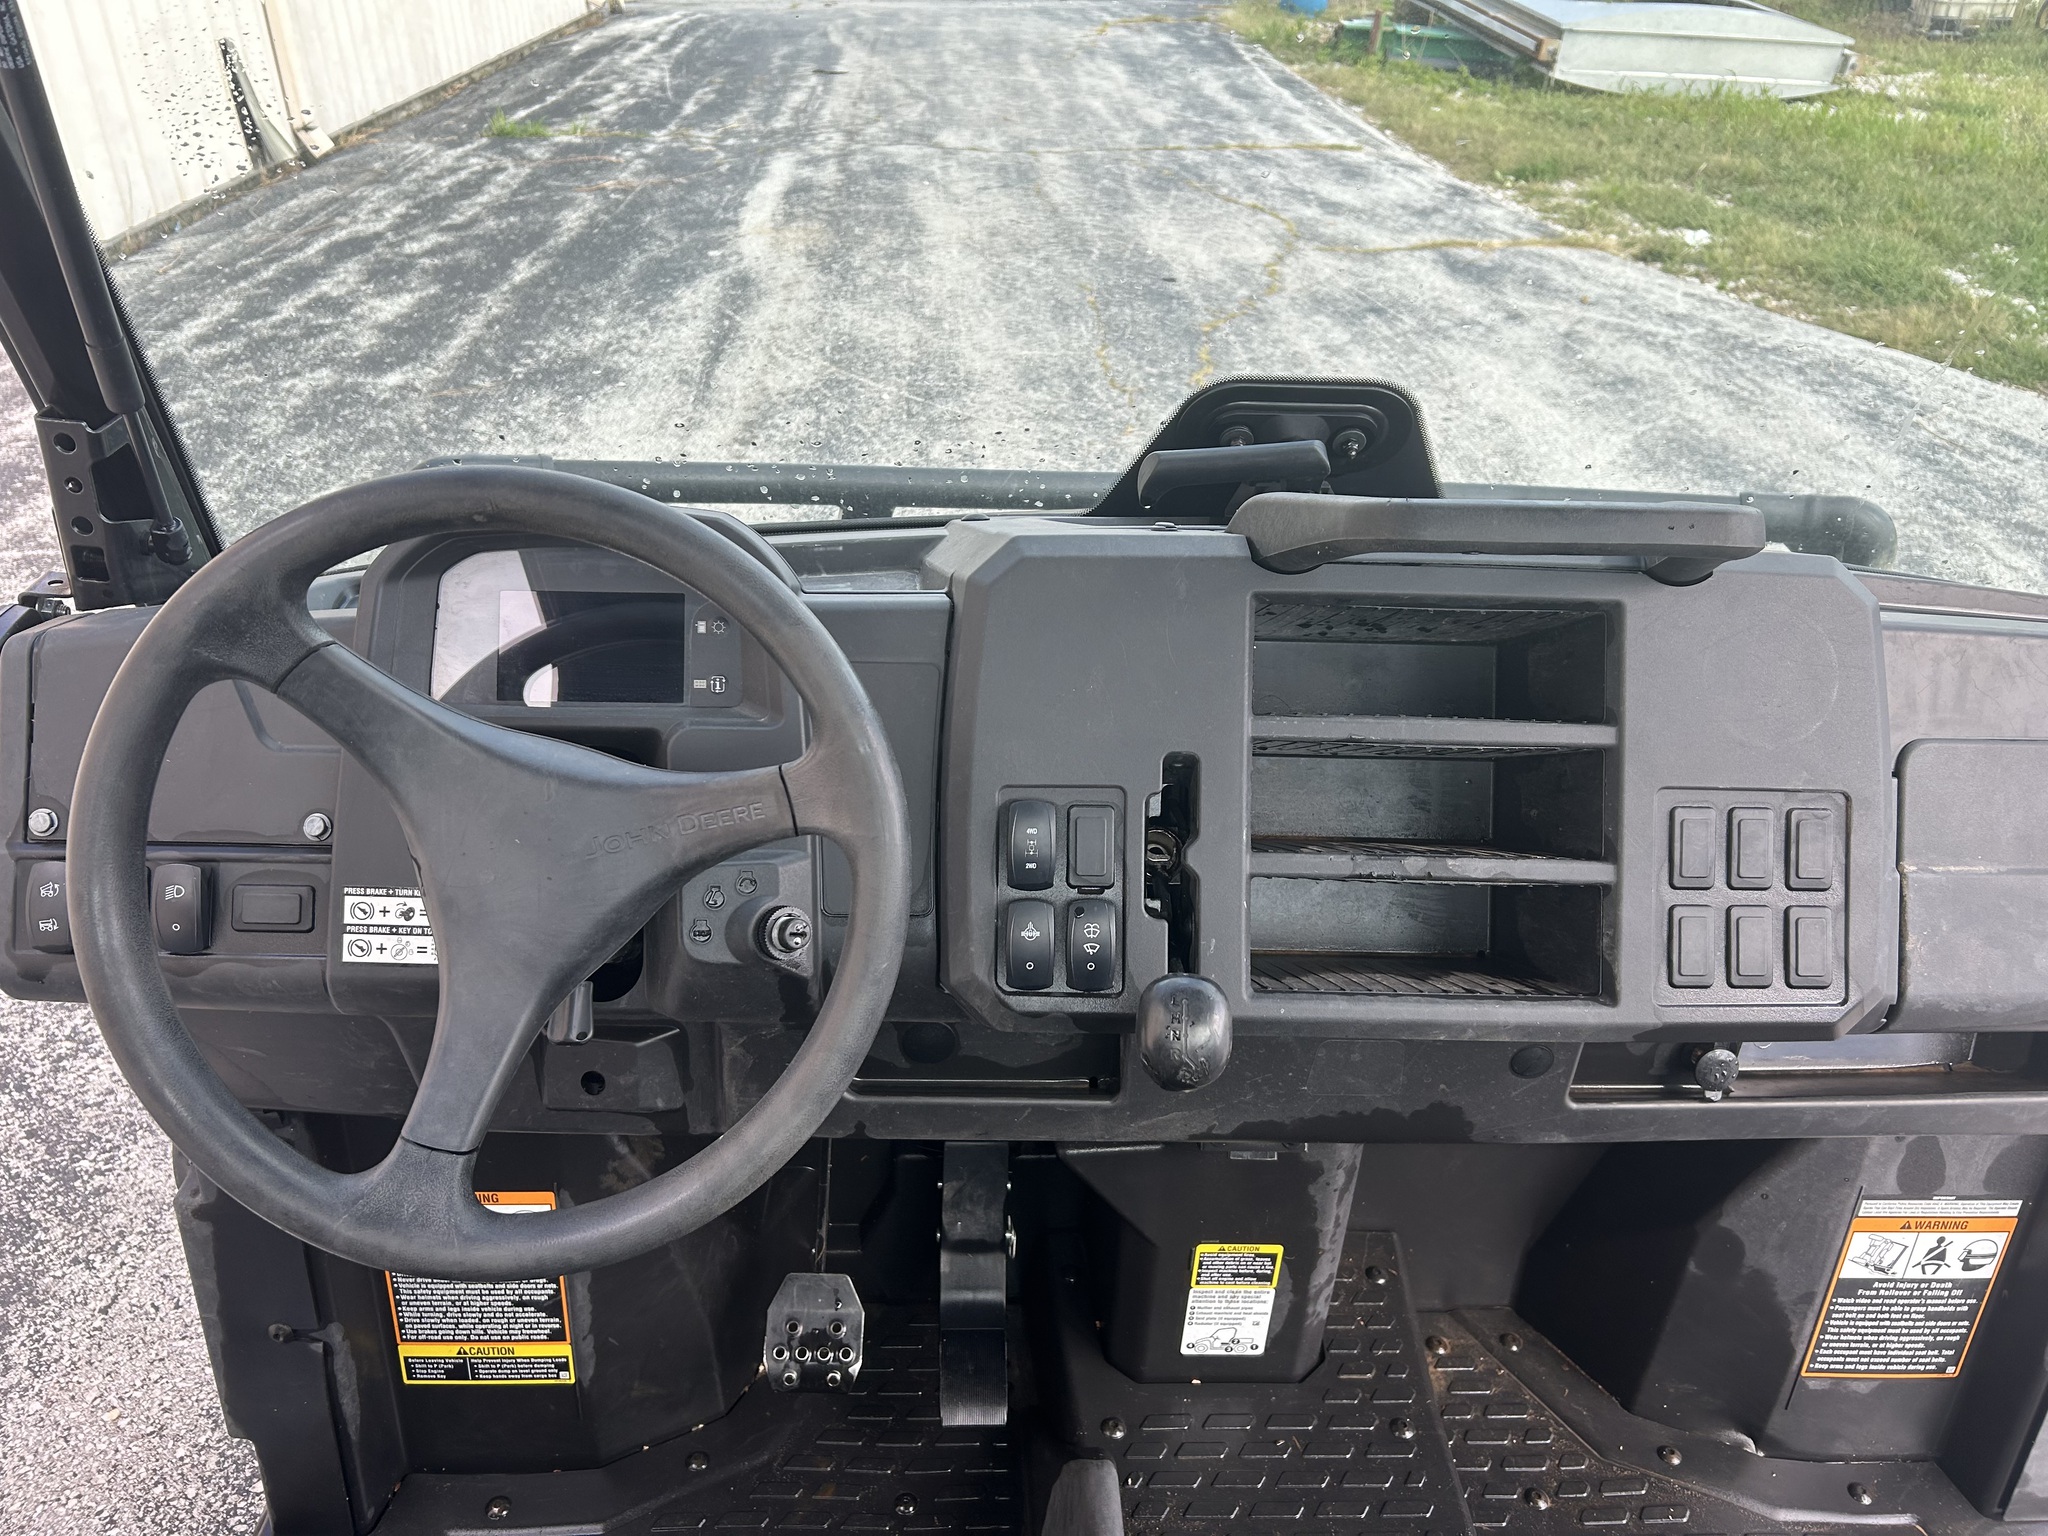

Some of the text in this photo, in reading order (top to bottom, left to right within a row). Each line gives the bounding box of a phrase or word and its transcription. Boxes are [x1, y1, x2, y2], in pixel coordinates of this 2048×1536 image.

[585, 801, 766, 859] JOHN DEERE
[1171, 1012, 1180, 1024] H
[1171, 1030, 1180, 1041] N
[1915, 1221, 1968, 1229] WARNING
[469, 1347, 515, 1355] CAUTION
